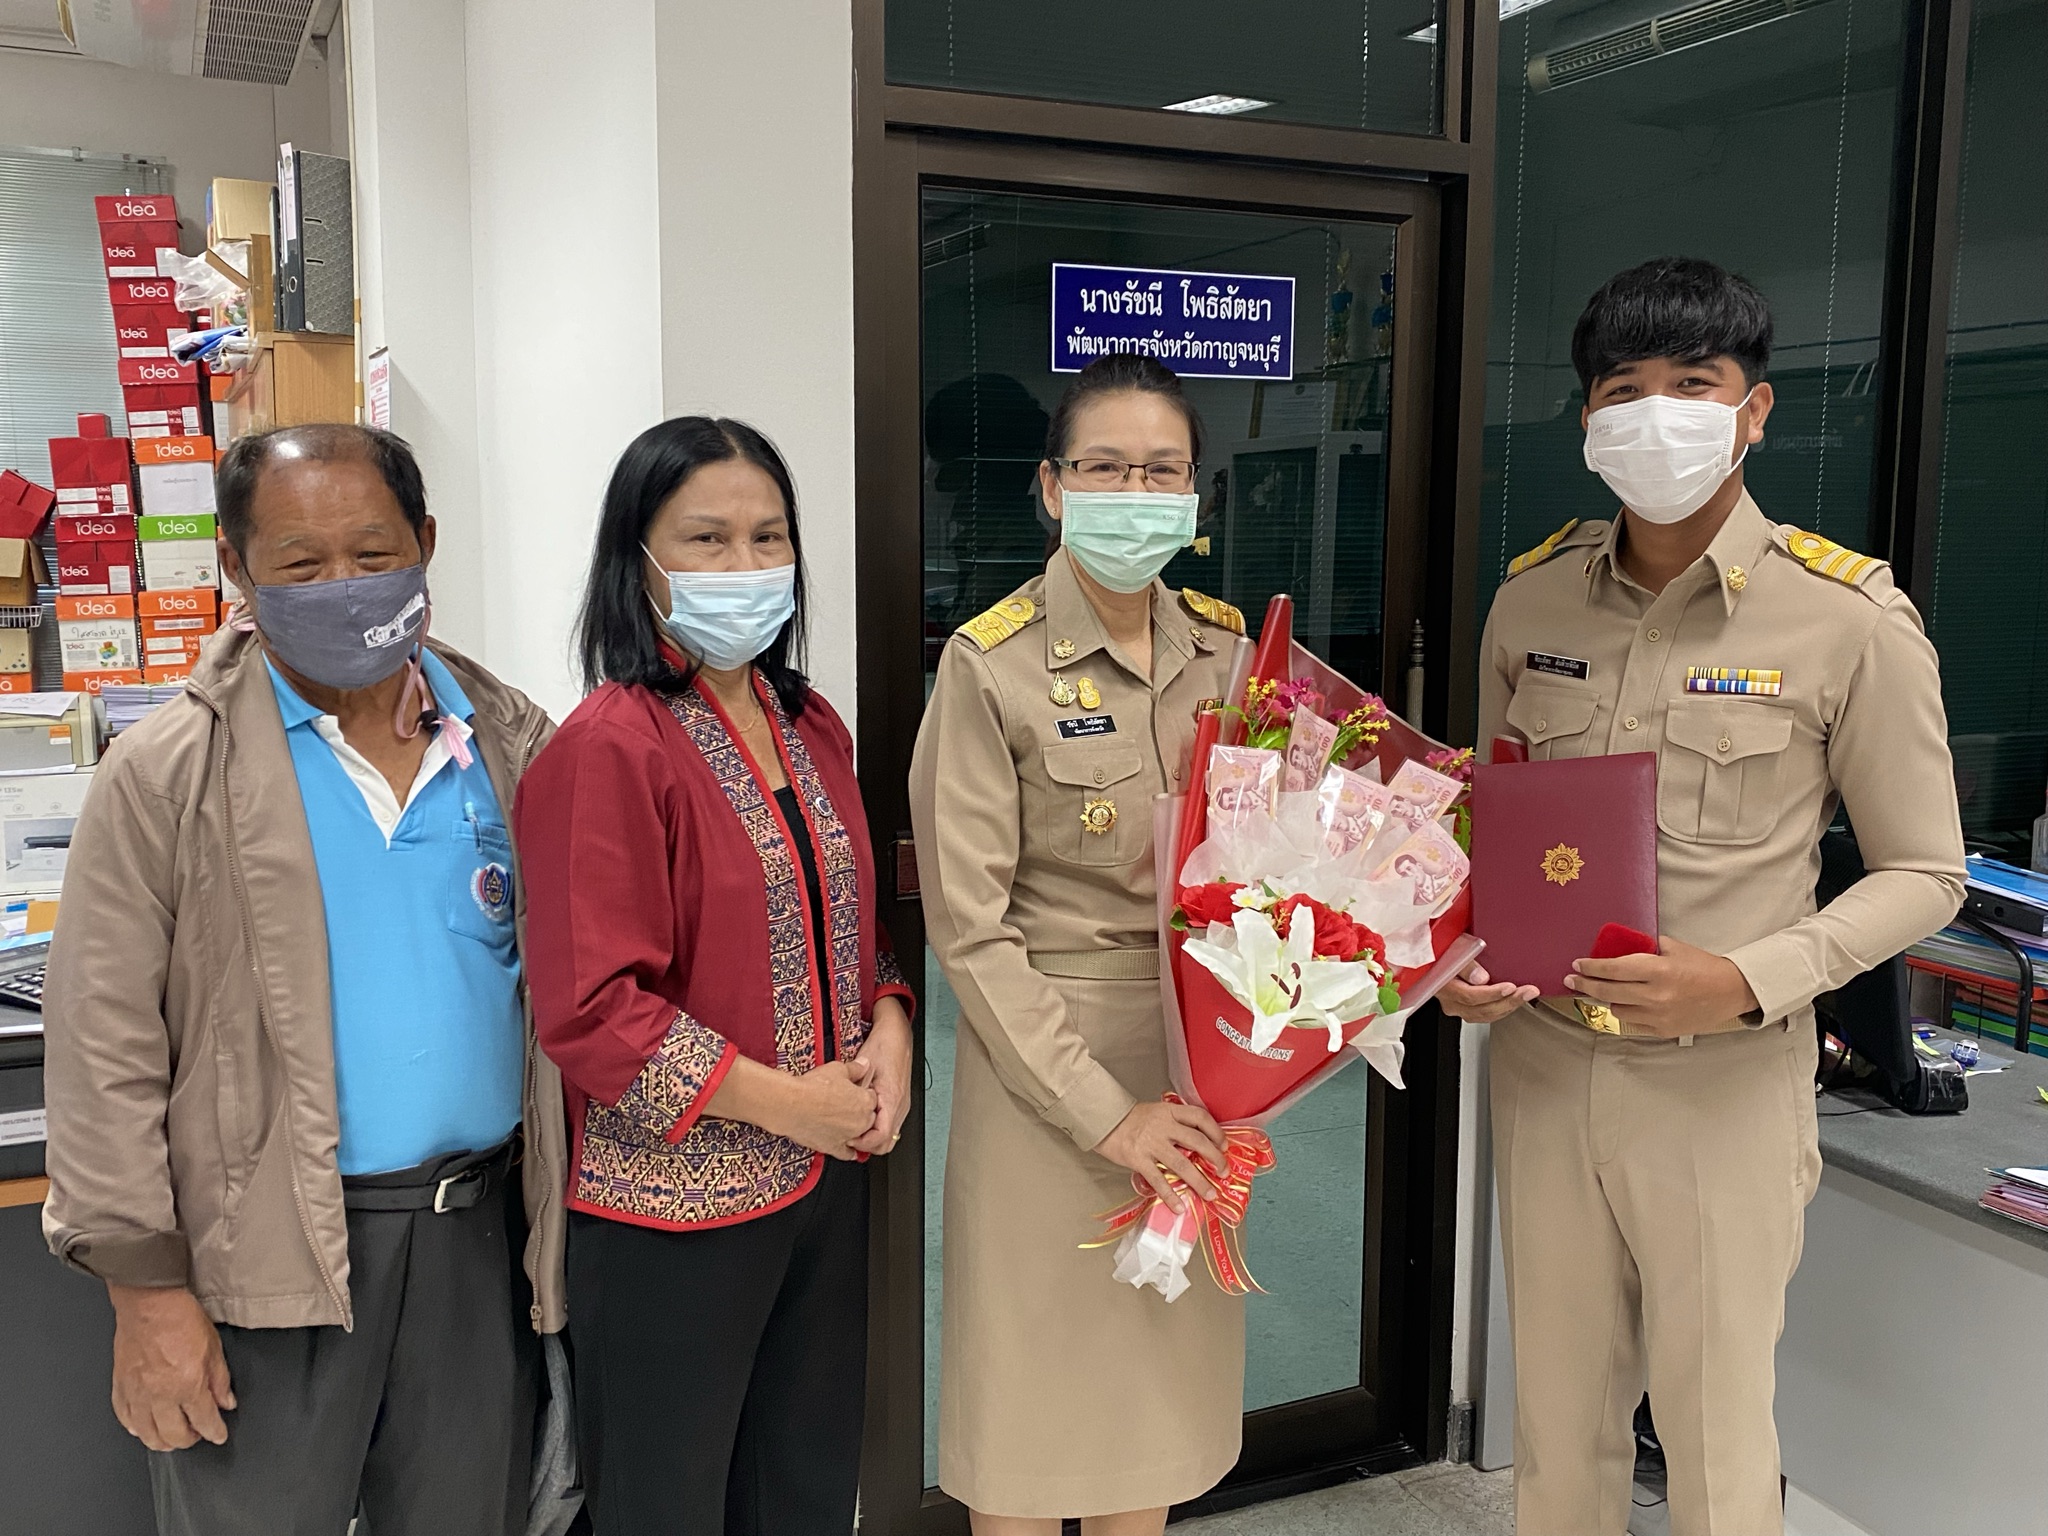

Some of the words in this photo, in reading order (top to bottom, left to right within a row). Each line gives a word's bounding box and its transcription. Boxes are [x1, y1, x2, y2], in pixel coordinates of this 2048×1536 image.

[115, 201, 157, 217] idea
[107, 246, 136, 258] idea
[128, 283, 169, 298] idea
[1080, 279, 1163, 317] นางรัชนี
[1180, 279, 1272, 322] โพธิสัตยา
[119, 328, 148, 339] idea
[1067, 326, 1282, 371] พัฒนาการจังหวัดกาญจนบุรี
[139, 364, 179, 379] idea
[154, 442, 195, 457] idea
[75, 520, 116, 536] idea
[158, 520, 197, 535] idea
[61, 566, 89, 576] idea
[75, 600, 116, 616] idea
[158, 595, 197, 610] idea
[1372, 798, 1383, 811] 00
